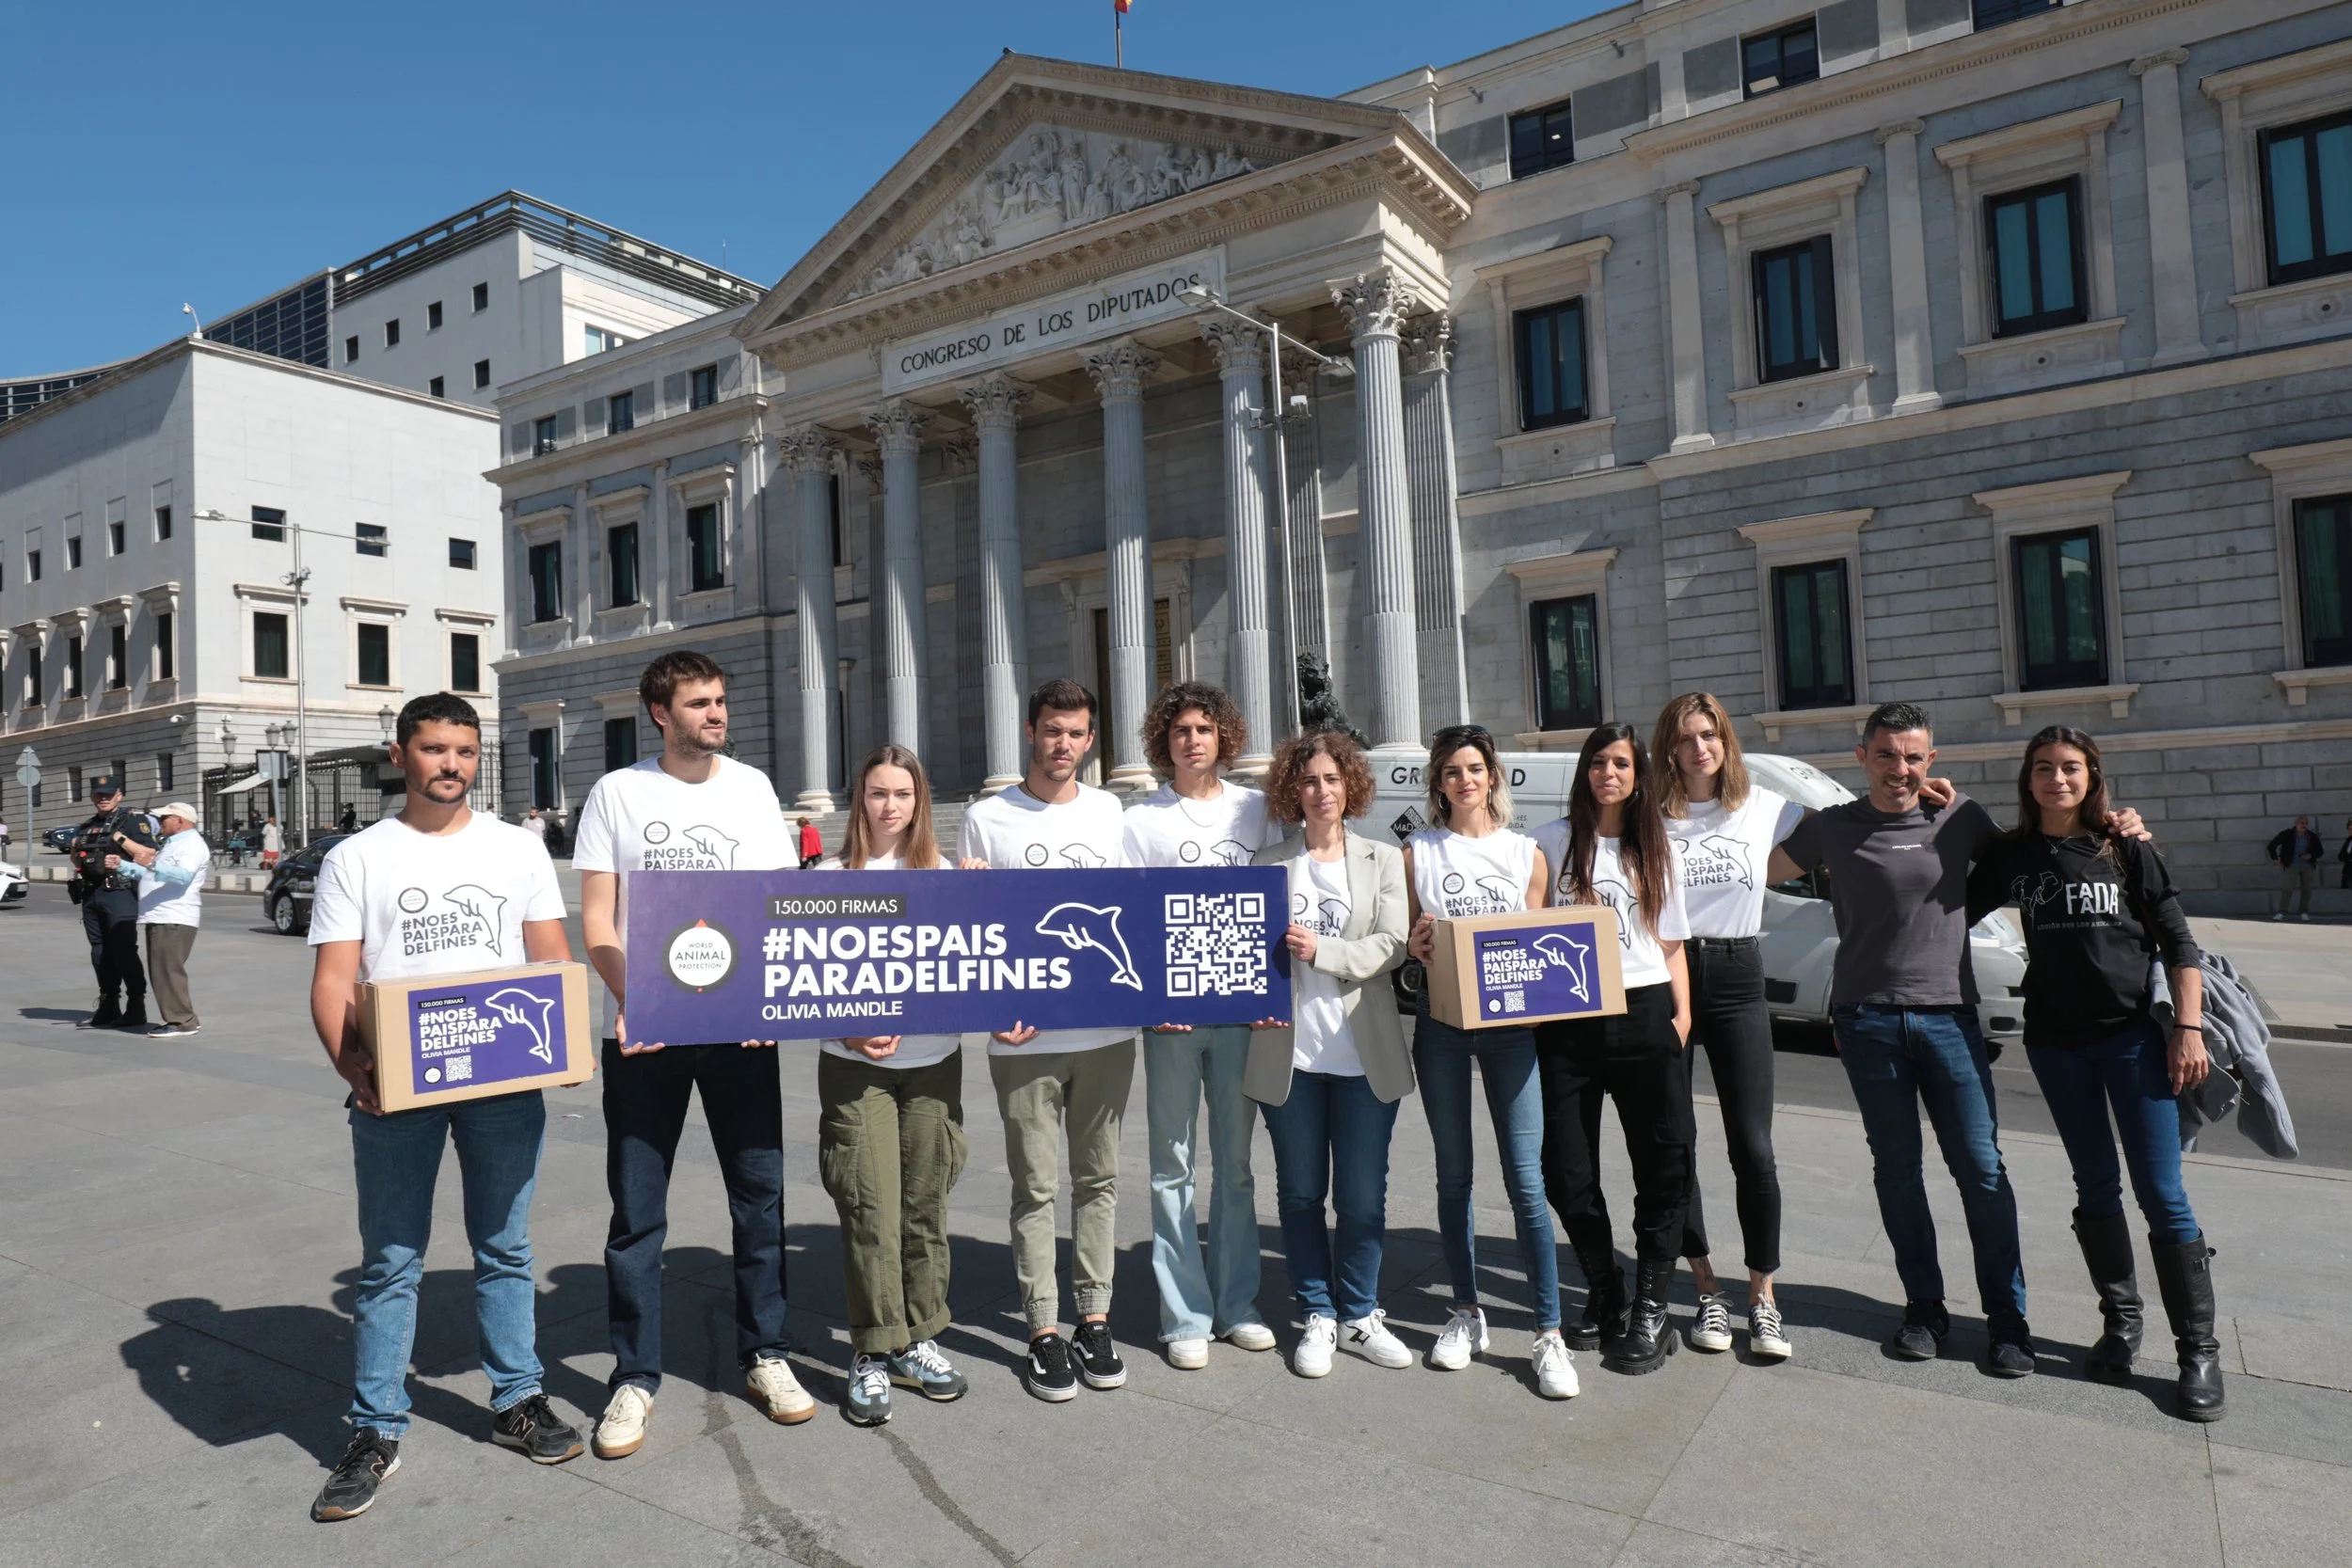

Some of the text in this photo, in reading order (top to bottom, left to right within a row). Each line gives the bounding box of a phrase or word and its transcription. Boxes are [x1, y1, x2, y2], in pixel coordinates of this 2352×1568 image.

[900, 274, 1200, 373] CONGRESO DE LOS DIPUTADOS
[1392, 823, 1414, 832] M&D
[644, 847, 694, 860] #NOES
[644, 859, 716, 870] PAISPARA
[1684, 863, 1735, 877] ISPARA
[1684, 873, 1731, 887] LFINES
[774, 898, 898, 915] 150.000 FIRMAS
[1445, 896, 1488, 910] #NOES
[402, 911, 458, 931] #NOES
[403, 921, 484, 943] PAISPARA
[405, 934, 477, 957] DELFINES
[762, 924, 1008, 961] #NOESPAIS
[675, 950, 726, 961] ANIMAL
[1482, 948, 1527, 962] #NOES
[1484, 958, 1548, 974] PAISPARA
[764, 957, 1072, 998] PARADELFINES
[1485, 969, 1543, 985] DELFINES
[421, 997, 464, 1008] 150.000 FIRMAS
[762, 1000, 903, 1020] OLIVIA MANDLE
[419, 1006, 477, 1026] #NOES
[420, 1017, 502, 1038] PAISPARA
[421, 1029, 497, 1052] DELFINES
[421, 1046, 471, 1059] OLIVIA MANDLE
